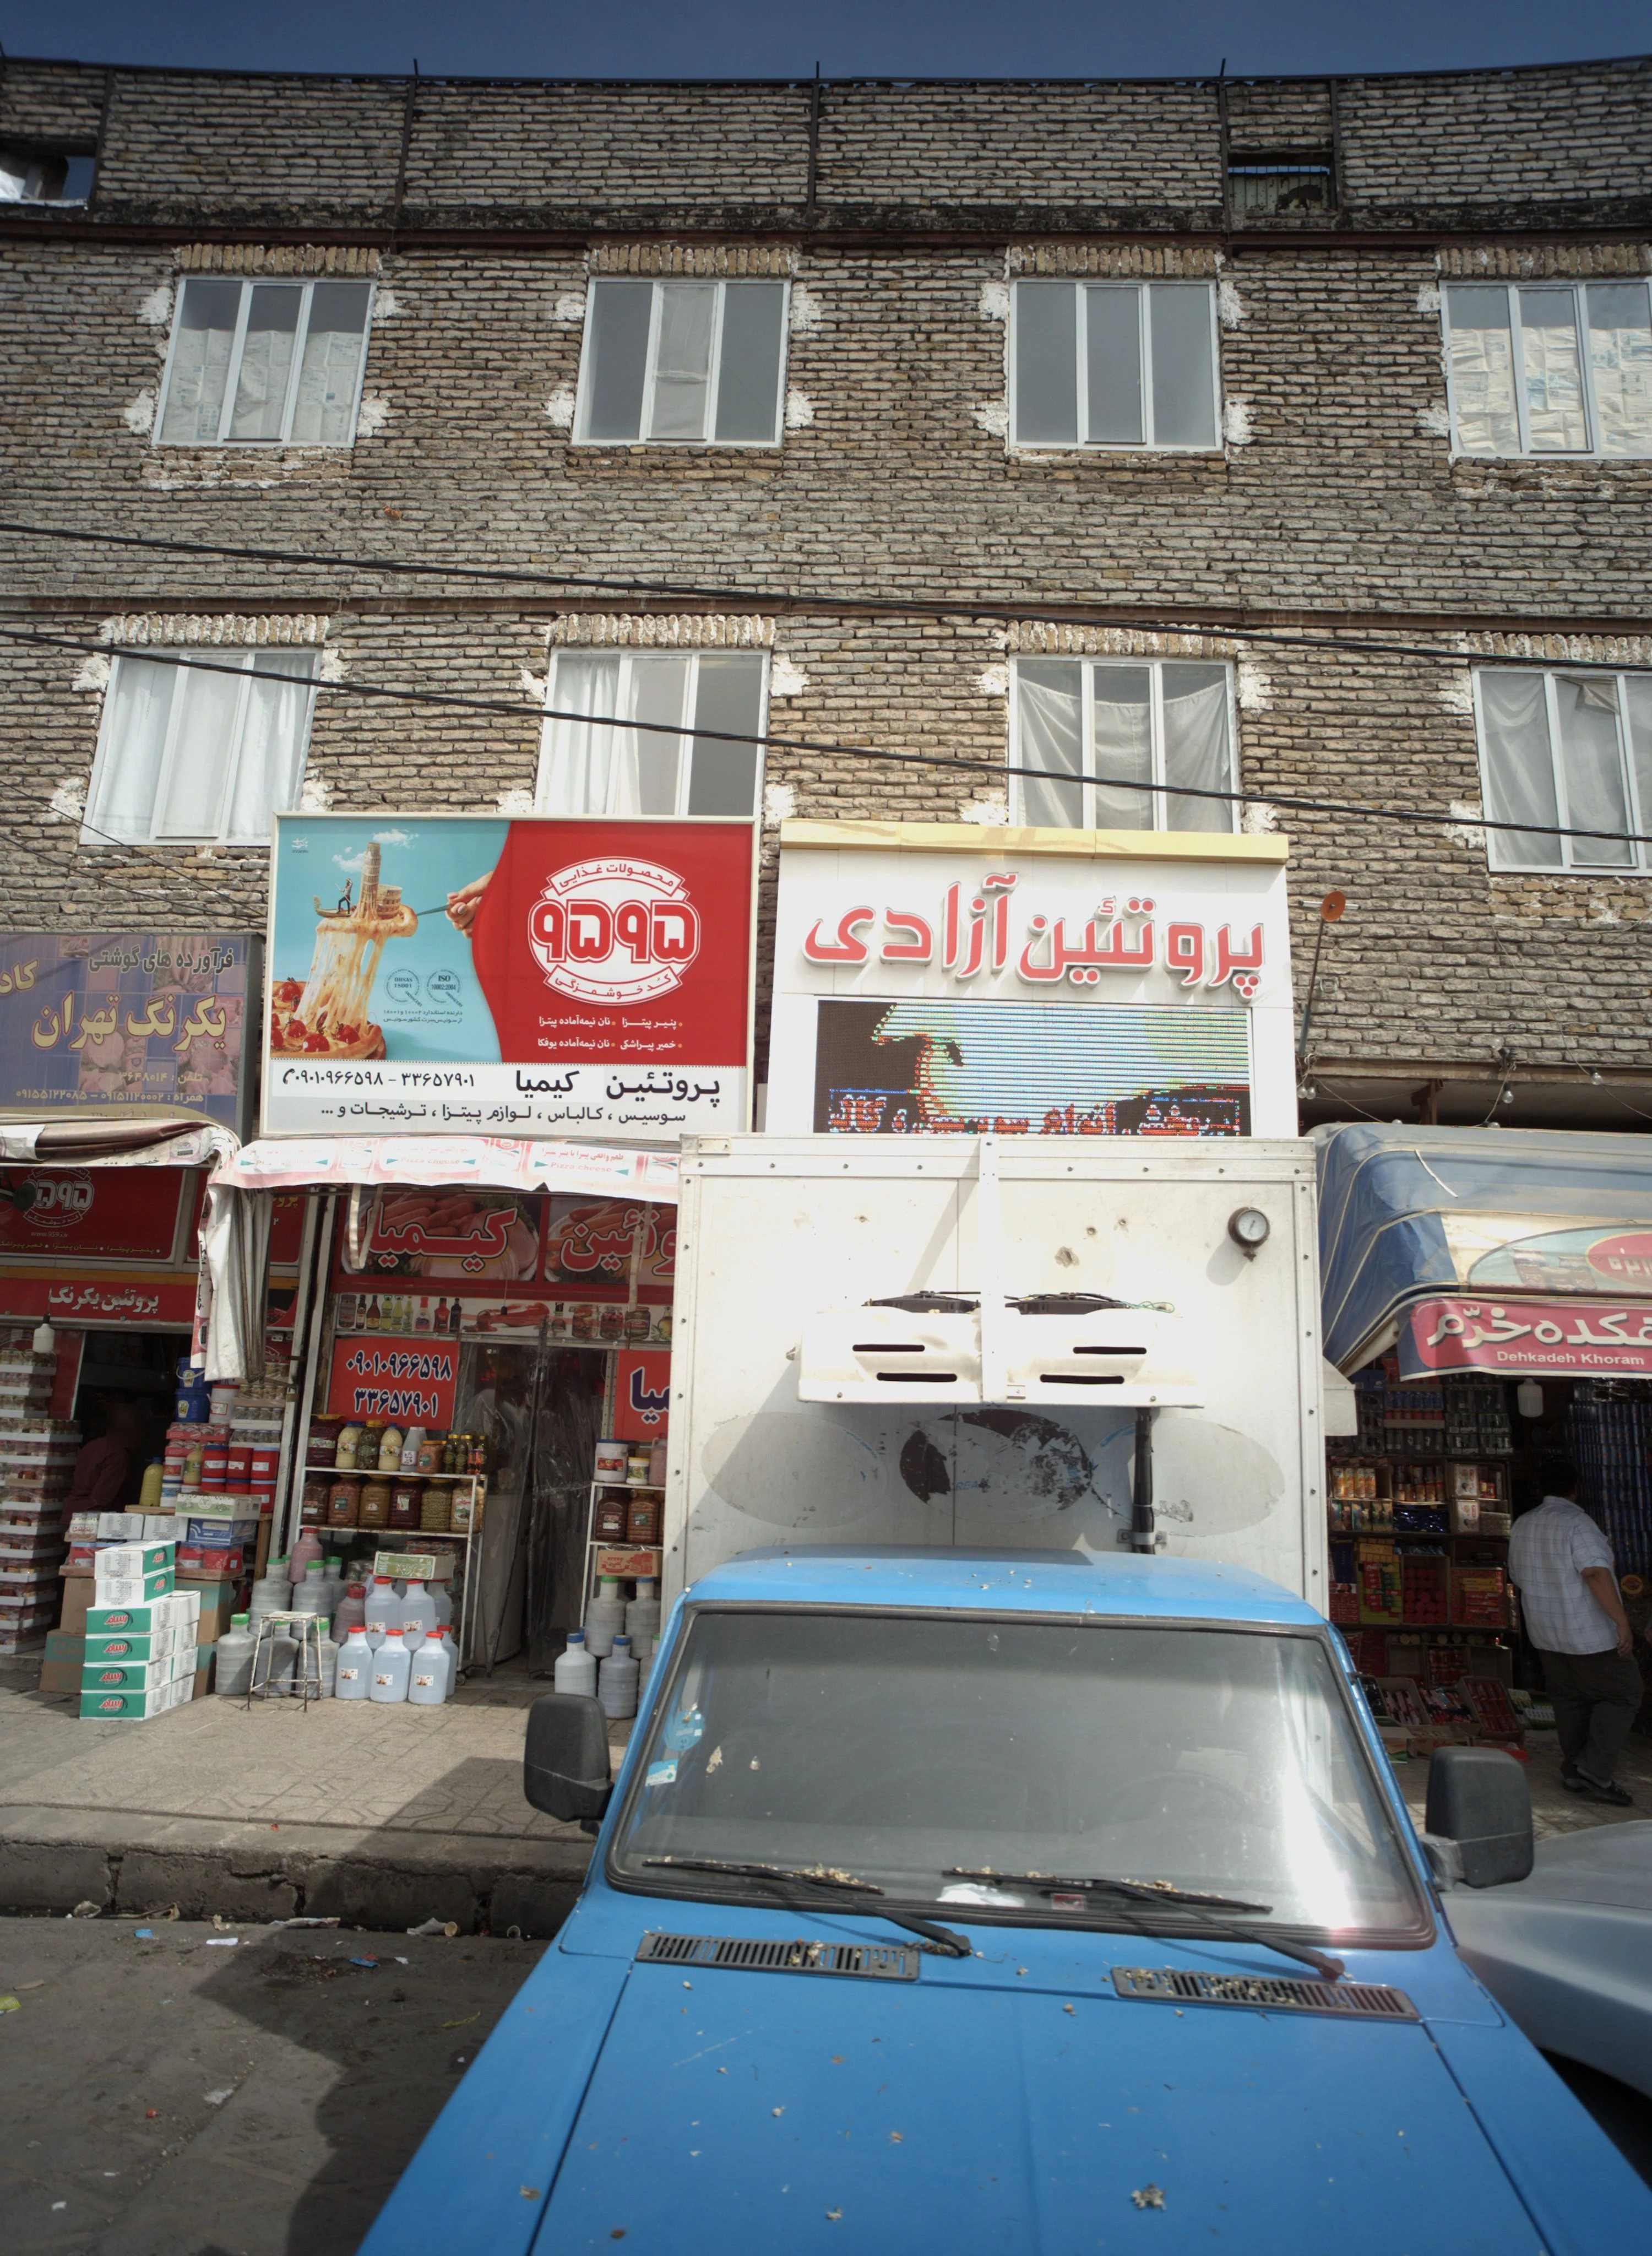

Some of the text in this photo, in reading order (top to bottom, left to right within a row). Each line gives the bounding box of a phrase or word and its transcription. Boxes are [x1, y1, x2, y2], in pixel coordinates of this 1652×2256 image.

[559, 863, 674, 888] محصولات غذایی
[802, 872, 1265, 1004] پروتئین آزادی
[89, 944, 233, 974] فرآورده های گوشتی
[32, 991, 227, 1052] یکرنگ تهران
[539, 1016, 557, 1028] پیتزا
[597, 1017, 611, 1026] نان
[622, 1017, 677, 1031] پنیر پیتزا
[537, 1038, 557, 1049] یوفکا
[597, 1039, 610, 1049] نان
[620, 1039, 676, 1051] خمیر پیراشکی
[178, 1073, 203, 1084] تلفن
[295, 1070, 383, 1085] ۰۹۰۱۰۹۶۶۵۹۸
[401, 1072, 474, 1086] ۳۳۶۵۷۹۰۱
[516, 1070, 720, 1108] پروتئین کیمیا
[174, 1092, 204, 1104] همراه
[338, 1105, 346, 1117] و
[350, 1102, 426, 1120] ترشیجات
[443, 1104, 481, 1124] پیتزا
[486, 1105, 531, 1121] لوازم
[548, 1107, 603, 1124] کالباس
[618, 1113, 686, 1125] سوسیس
[366, 1201, 518, 1271] کیمیا
[101, 1289, 159, 1314] پروتئین
[346, 1350, 453, 1381] ۰۹۰۱۰۹۶۶۵۹۸
[1497, 1351, 1645, 1365] Dehkadeh Khoram
[354, 1387, 438, 1418] ۳۳۶۵۷۹۰۱
